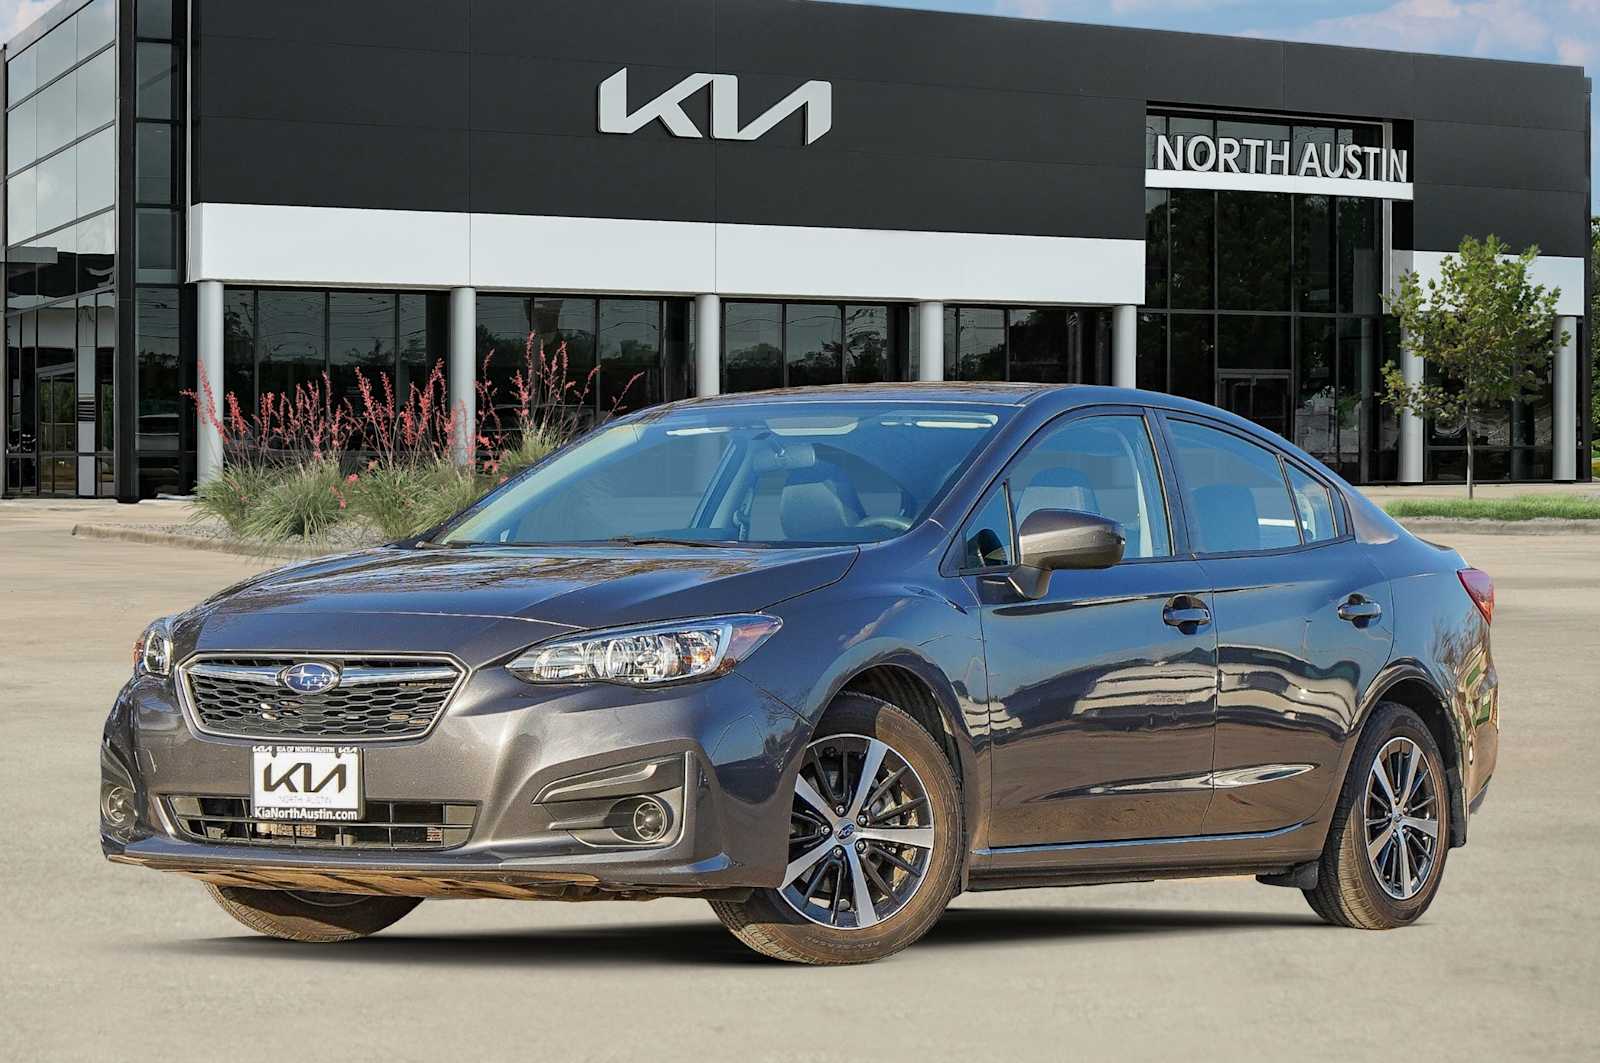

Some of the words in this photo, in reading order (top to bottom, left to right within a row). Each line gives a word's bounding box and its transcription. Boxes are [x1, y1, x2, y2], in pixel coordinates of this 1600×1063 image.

[599, 67, 832, 145] KIA
[1157, 134, 1290, 175] NORTH
[1299, 142, 1408, 182] AUSTIN
[264, 762, 347, 793] KIA
[254, 807, 358, 820] KiaNorthAustin.com
